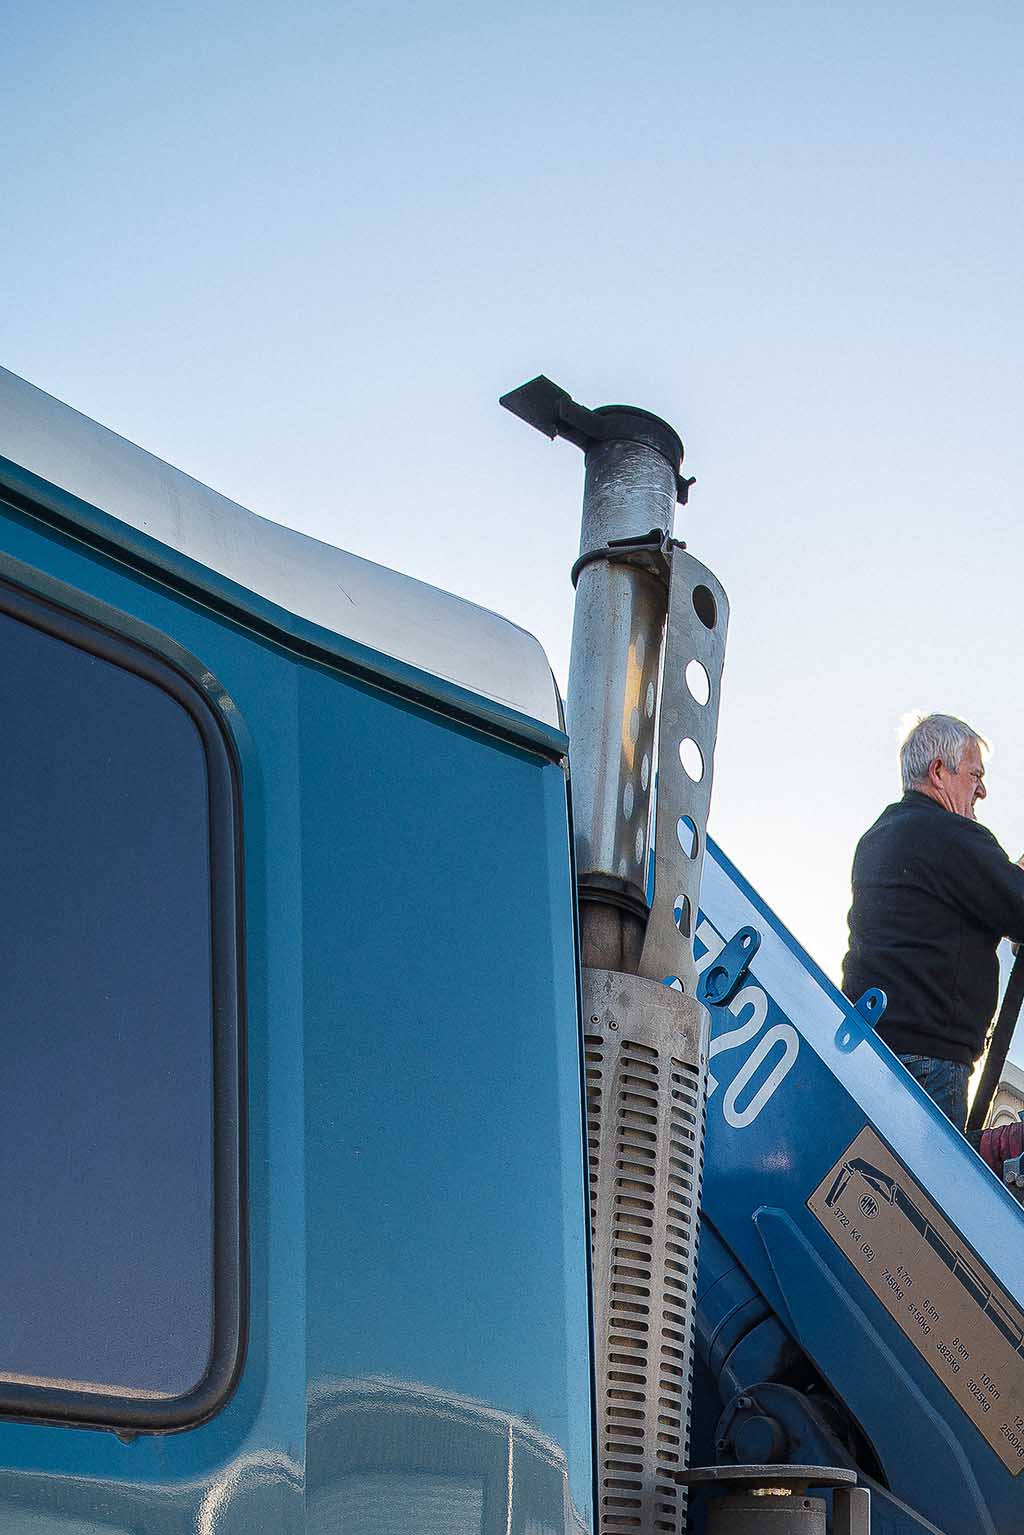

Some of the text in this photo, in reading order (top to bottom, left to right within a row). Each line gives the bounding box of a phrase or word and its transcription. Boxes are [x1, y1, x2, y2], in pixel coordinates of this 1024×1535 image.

[833, 1207, 850, 1229] 3722
[849, 1227, 862, 1242] K4
[859, 1242, 877, 1263] (B2)
[907, 1303, 931, 1336] 5150kg
[936, 1341, 961, 1374] 3825kg
[966, 1379, 991, 1413] 3025kg
[1000, 1423, 1024, 1458] 2500kg
